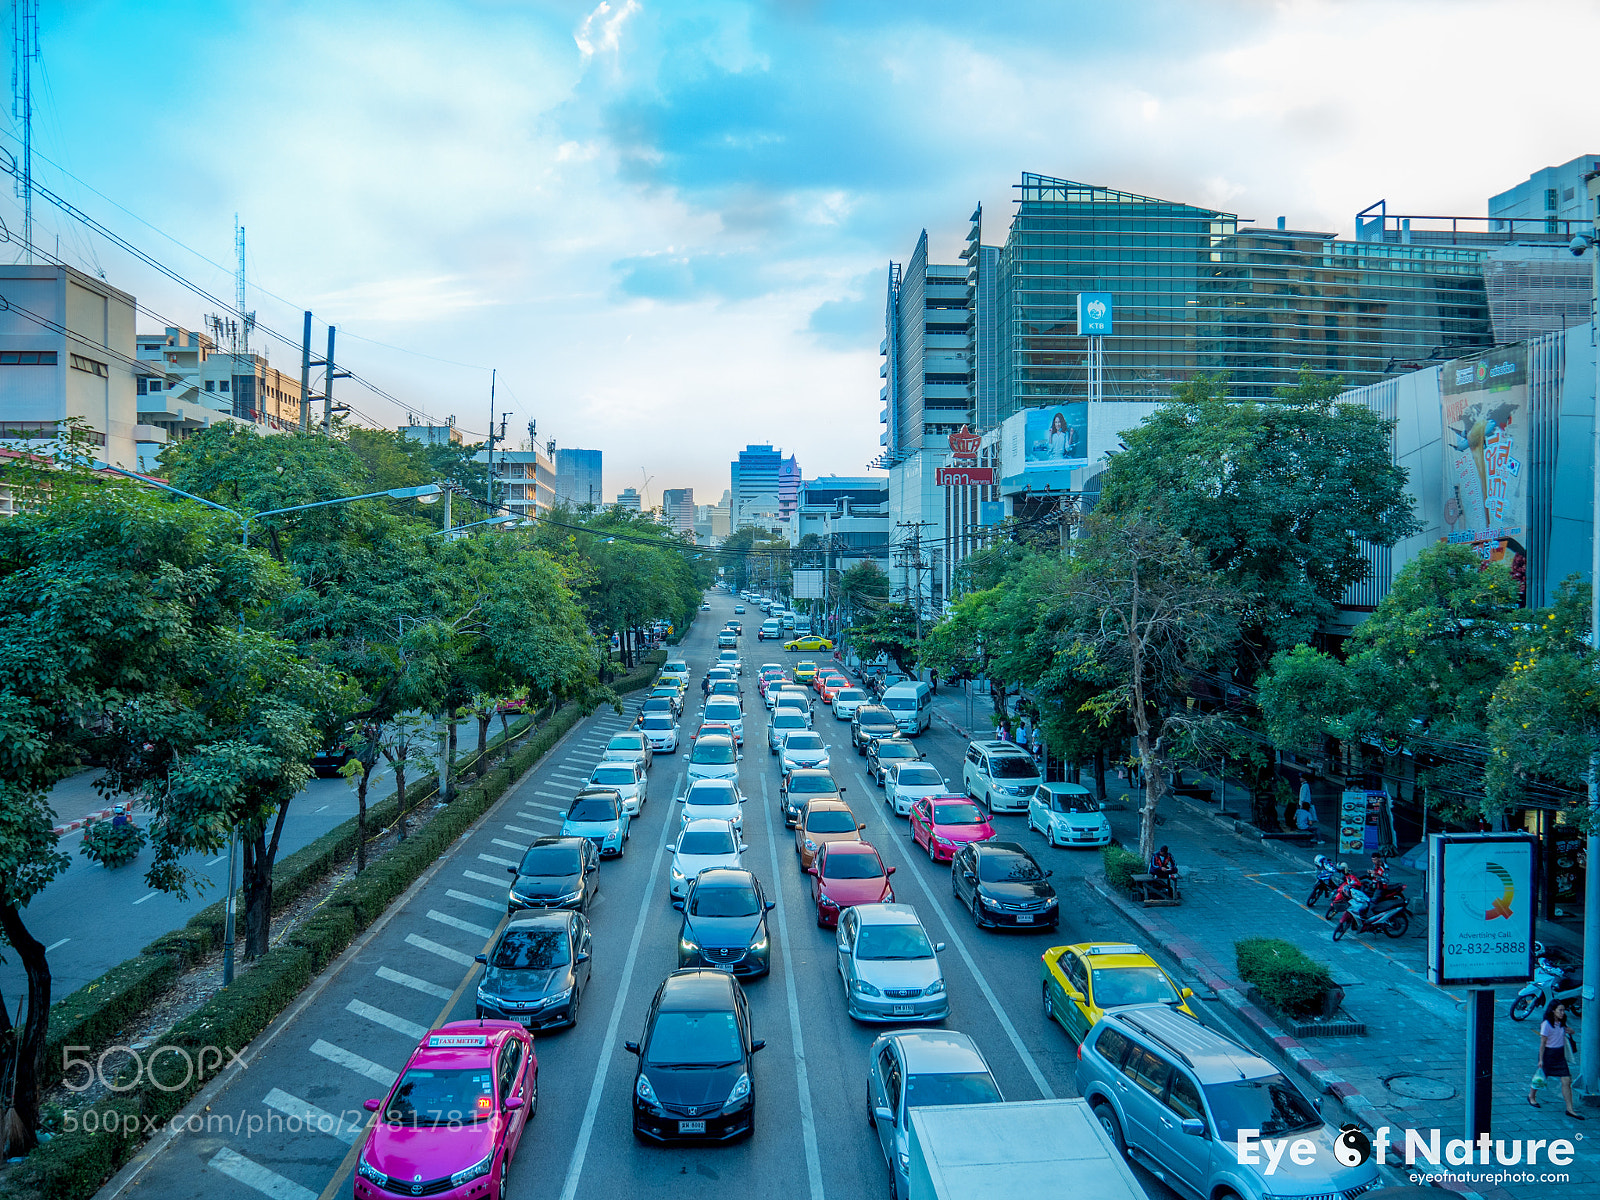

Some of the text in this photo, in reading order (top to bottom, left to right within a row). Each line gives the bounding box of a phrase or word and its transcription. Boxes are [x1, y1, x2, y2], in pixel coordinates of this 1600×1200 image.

[939, 469, 969, 485] โคคา
[1459, 932, 1496, 940] Advertising
[1447, 942, 1526, 955] 02-832-5888
